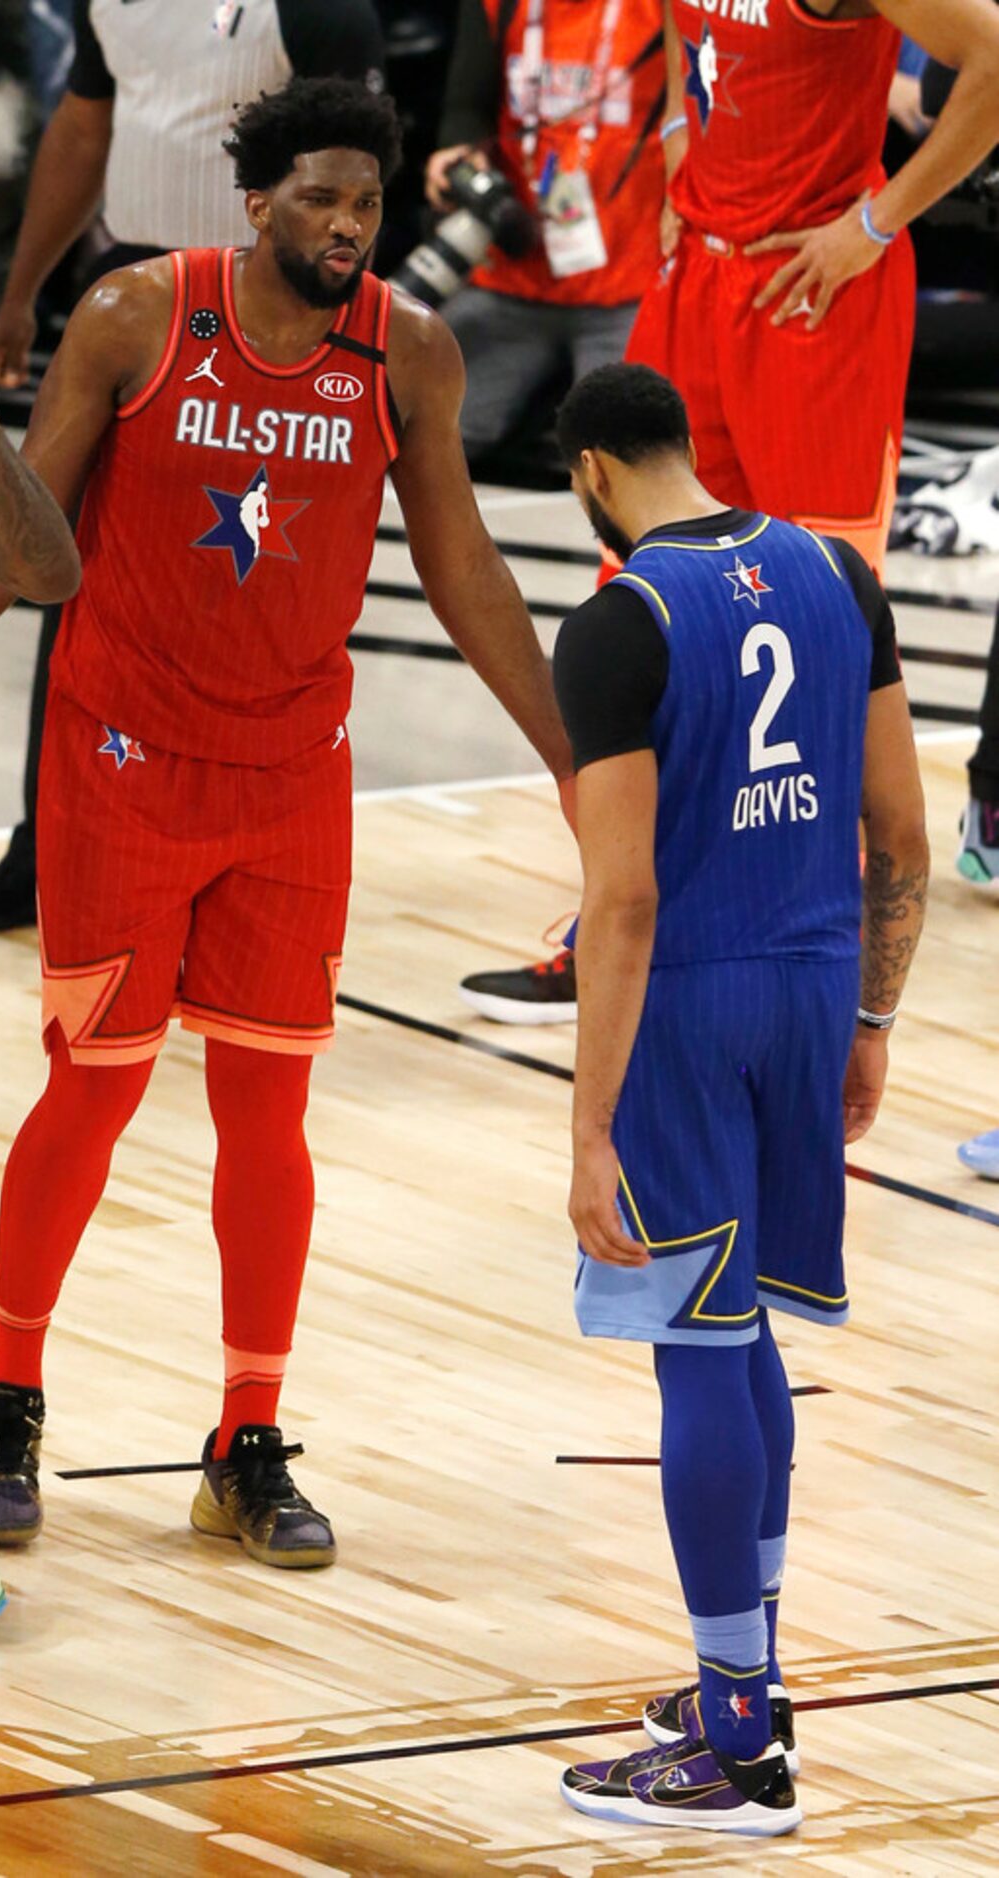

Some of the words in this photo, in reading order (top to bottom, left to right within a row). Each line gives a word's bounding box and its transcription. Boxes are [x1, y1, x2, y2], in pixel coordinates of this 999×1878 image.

[321, 377, 356, 397] KIA
[175, 396, 353, 464] ALL-STAR
[740, 622, 802, 774] 2
[732, 773, 820, 831] DAVIS
